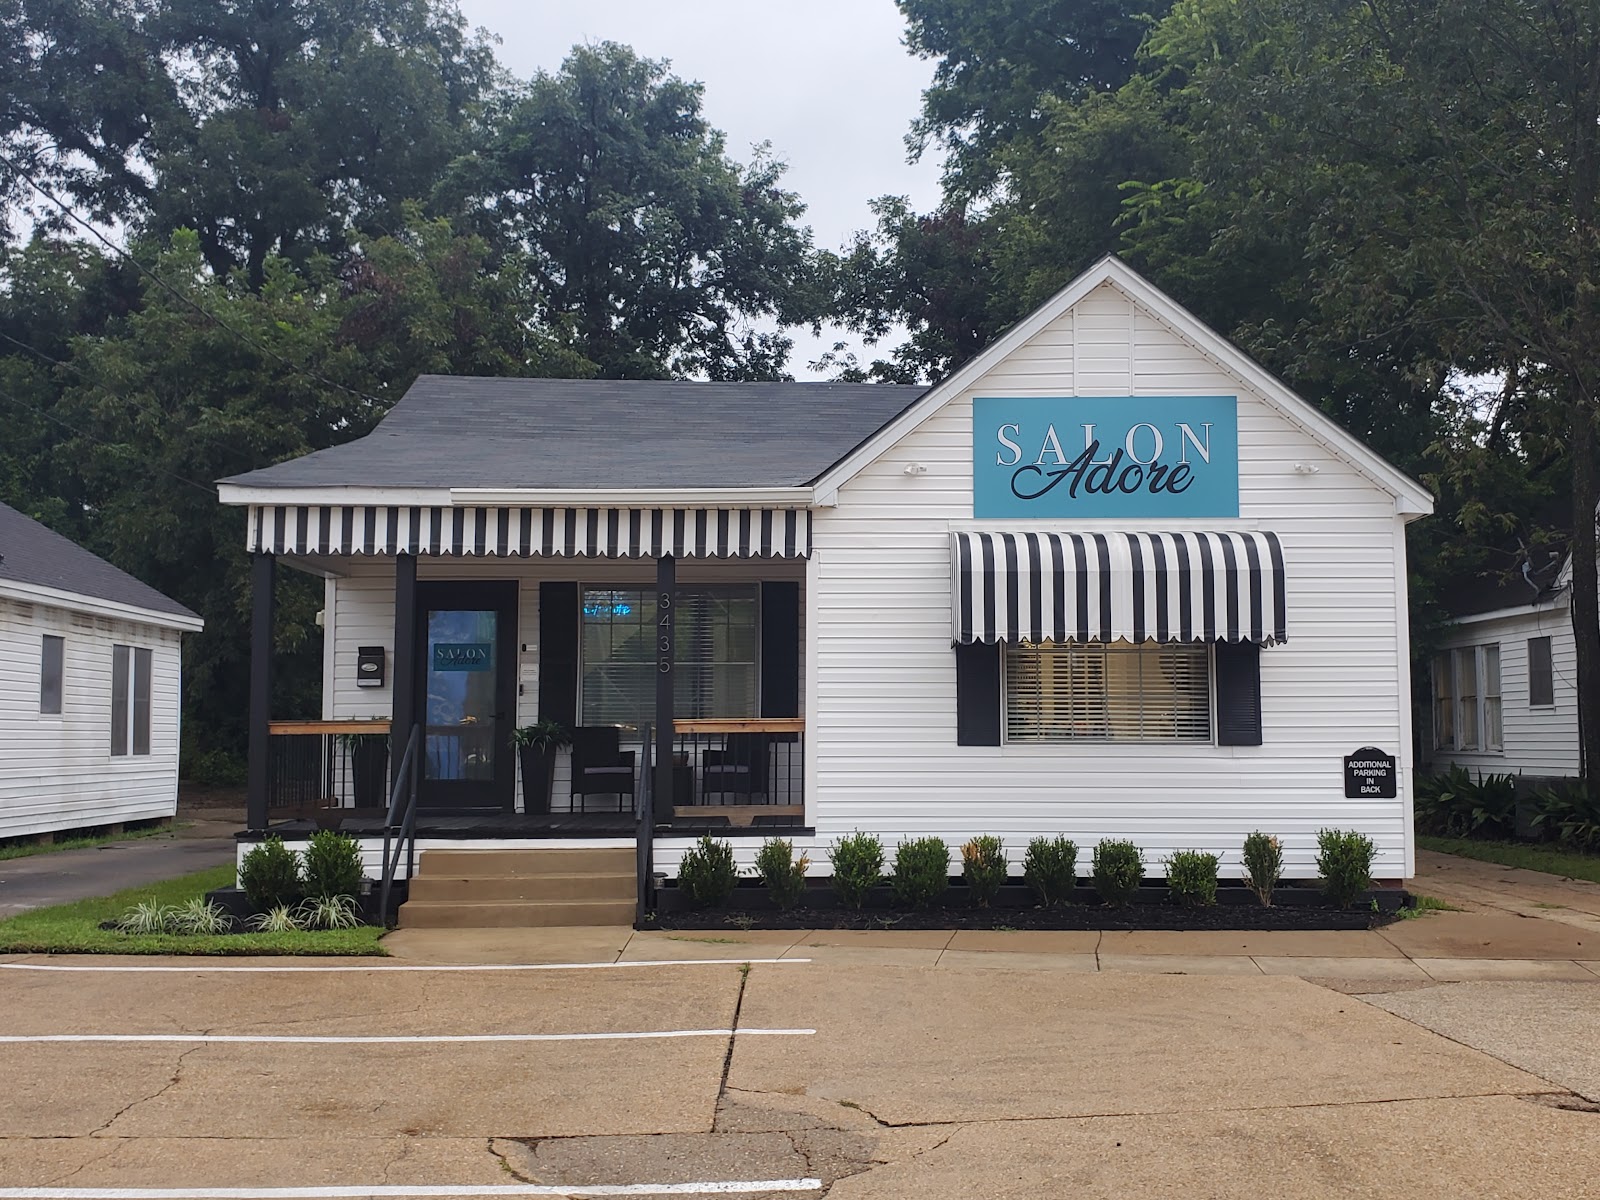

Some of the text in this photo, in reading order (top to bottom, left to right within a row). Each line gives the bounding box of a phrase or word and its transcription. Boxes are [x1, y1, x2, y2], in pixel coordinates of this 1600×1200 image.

[996, 422, 1214, 467] SALON
[1011, 439, 1195, 500] Adore
[660, 593, 671, 673] 3435
[437, 648, 487, 659] SALON
[441, 653, 482, 666] Adore
[1360, 785, 1381, 793] BACK
